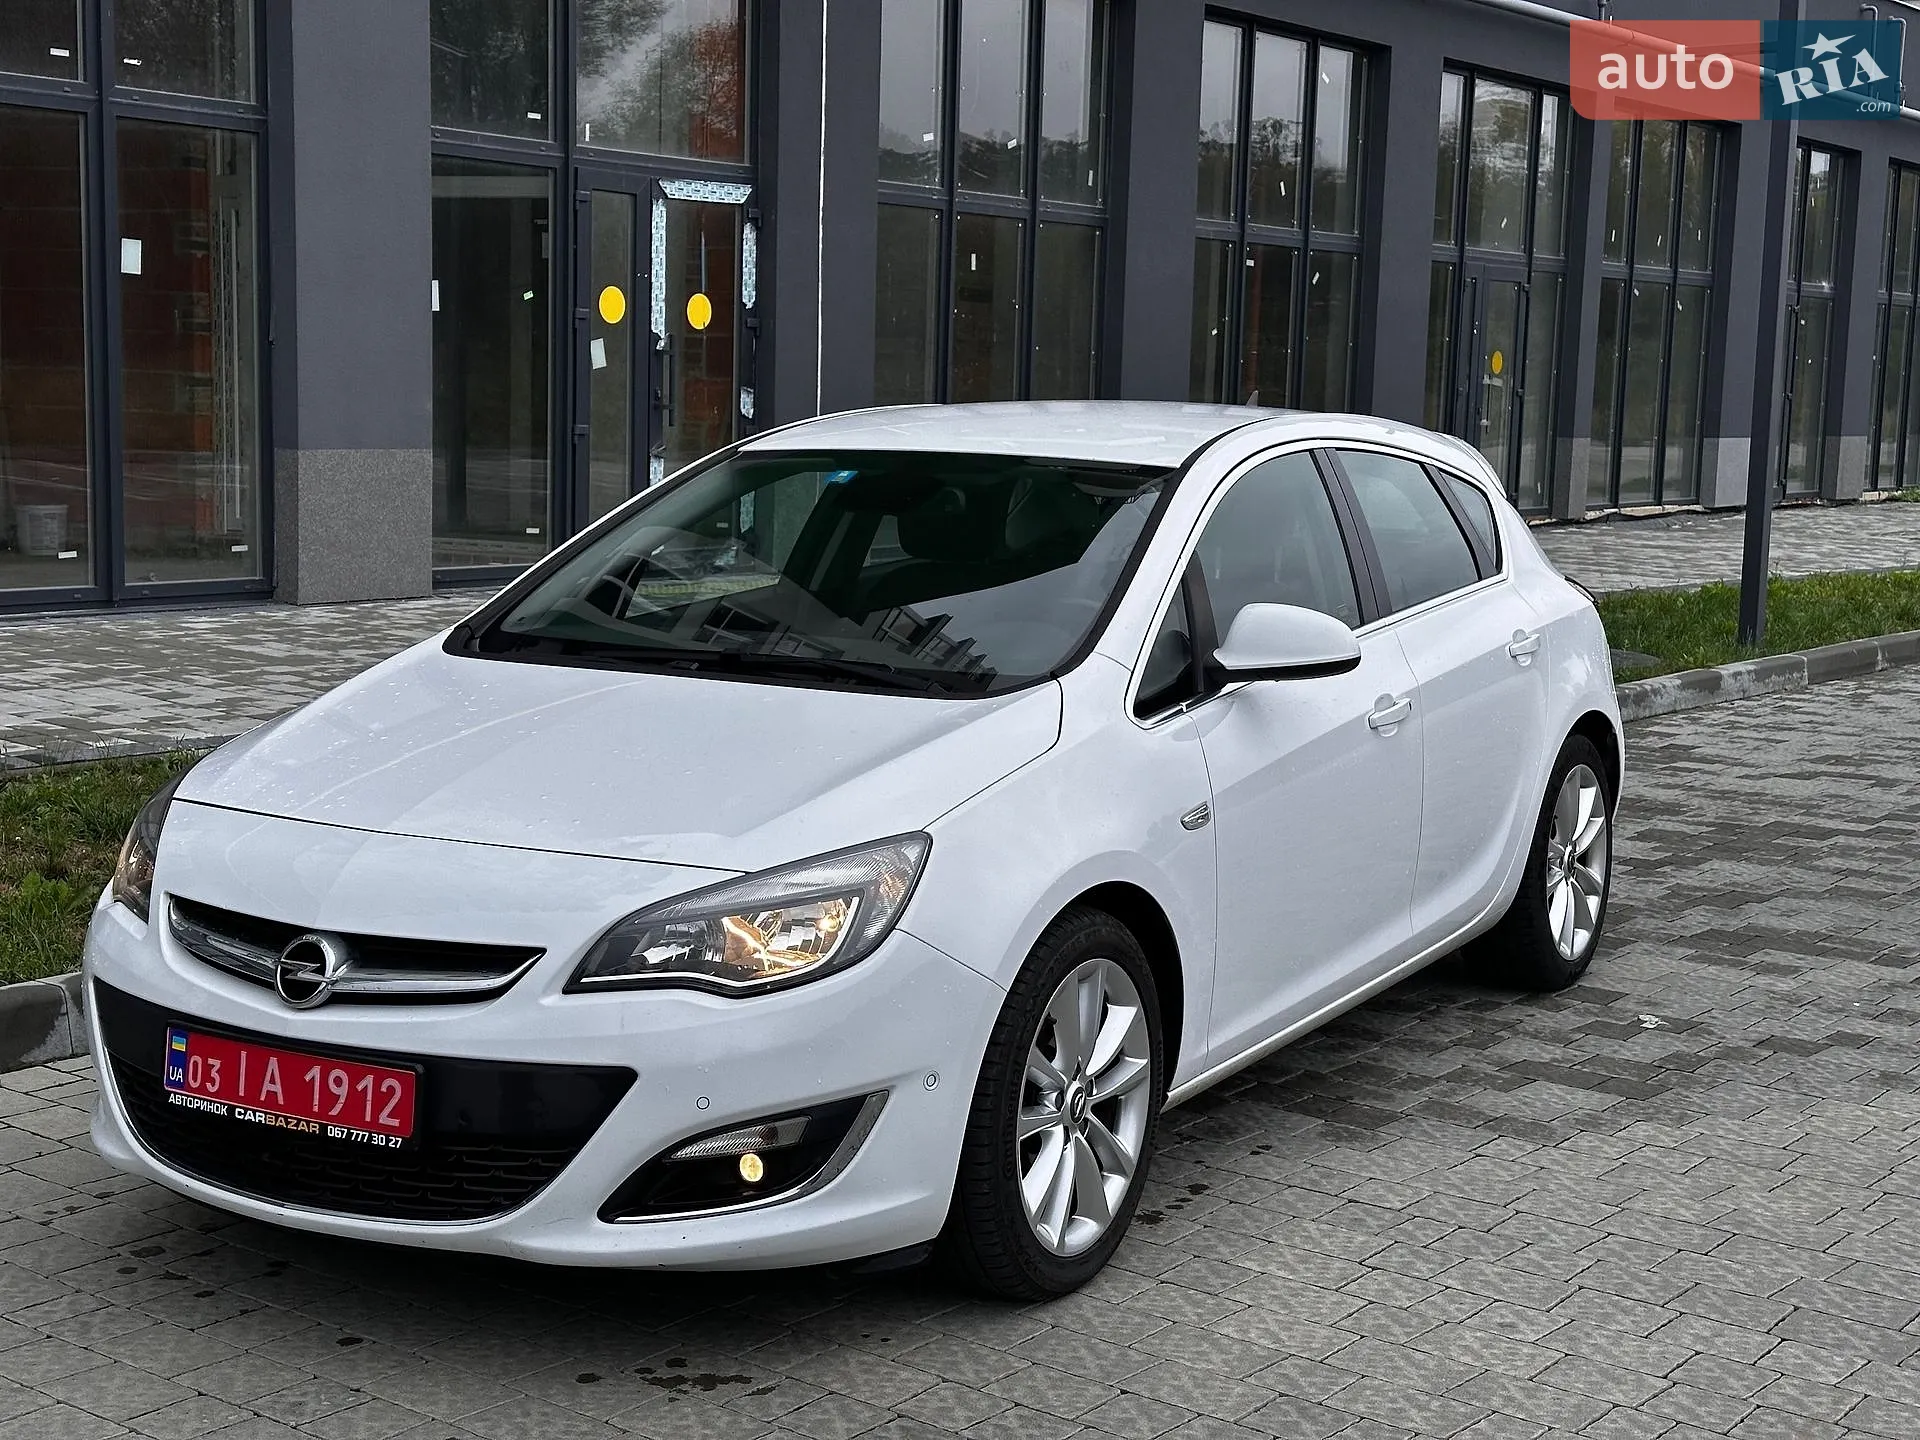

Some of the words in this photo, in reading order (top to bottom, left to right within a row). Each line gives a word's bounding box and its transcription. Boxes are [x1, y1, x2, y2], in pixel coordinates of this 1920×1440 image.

[169, 1066, 183, 1082] UA
[188, 1055, 222, 1092] 03
[304, 1065, 402, 1127] 1912
[168, 1093, 228, 1116] АВТОРИНОК
[235, 1107, 320, 1134] CARBAZAR
[327, 1125, 347, 1139] 067
[350, 1130, 369, 1143] 777
[371, 1133, 386, 1146] 30
[388, 1136, 403, 1149] 27
